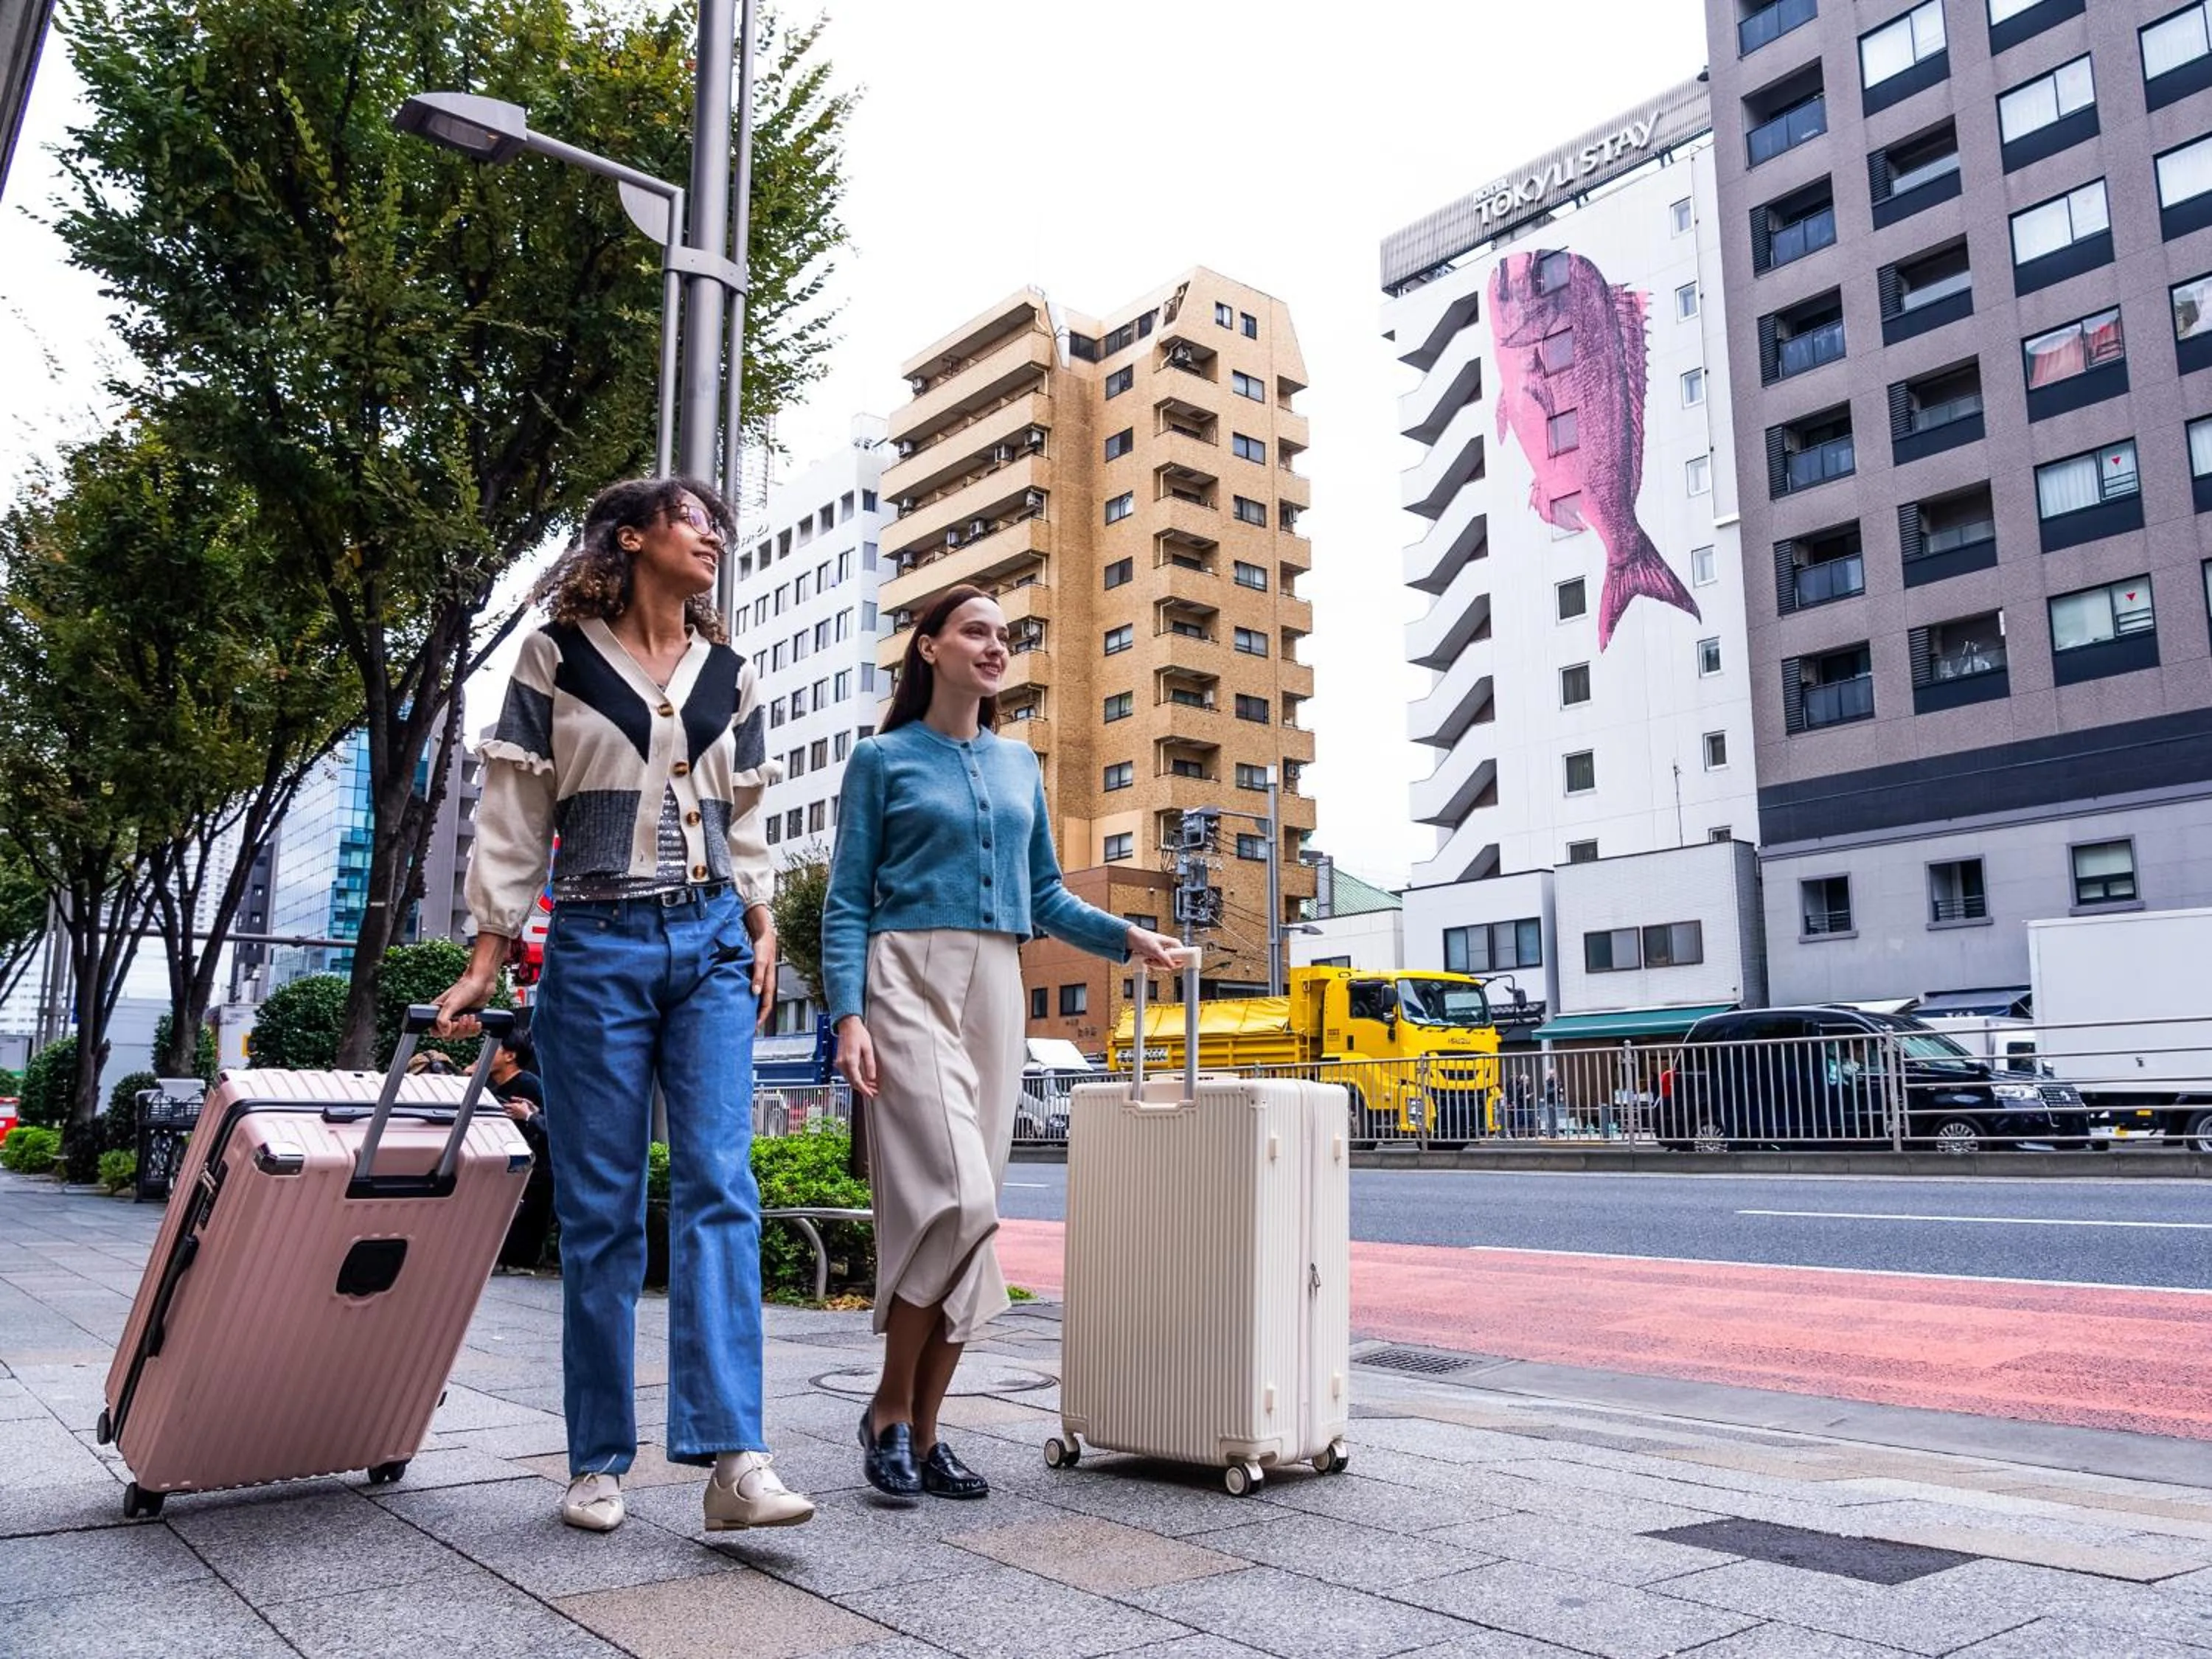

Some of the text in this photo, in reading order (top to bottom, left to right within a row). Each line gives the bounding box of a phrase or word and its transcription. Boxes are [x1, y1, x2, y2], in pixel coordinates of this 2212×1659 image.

[1474, 111, 1661, 224] TOKYU STAY
[1448, 1037, 1471, 1045] ISUZU
